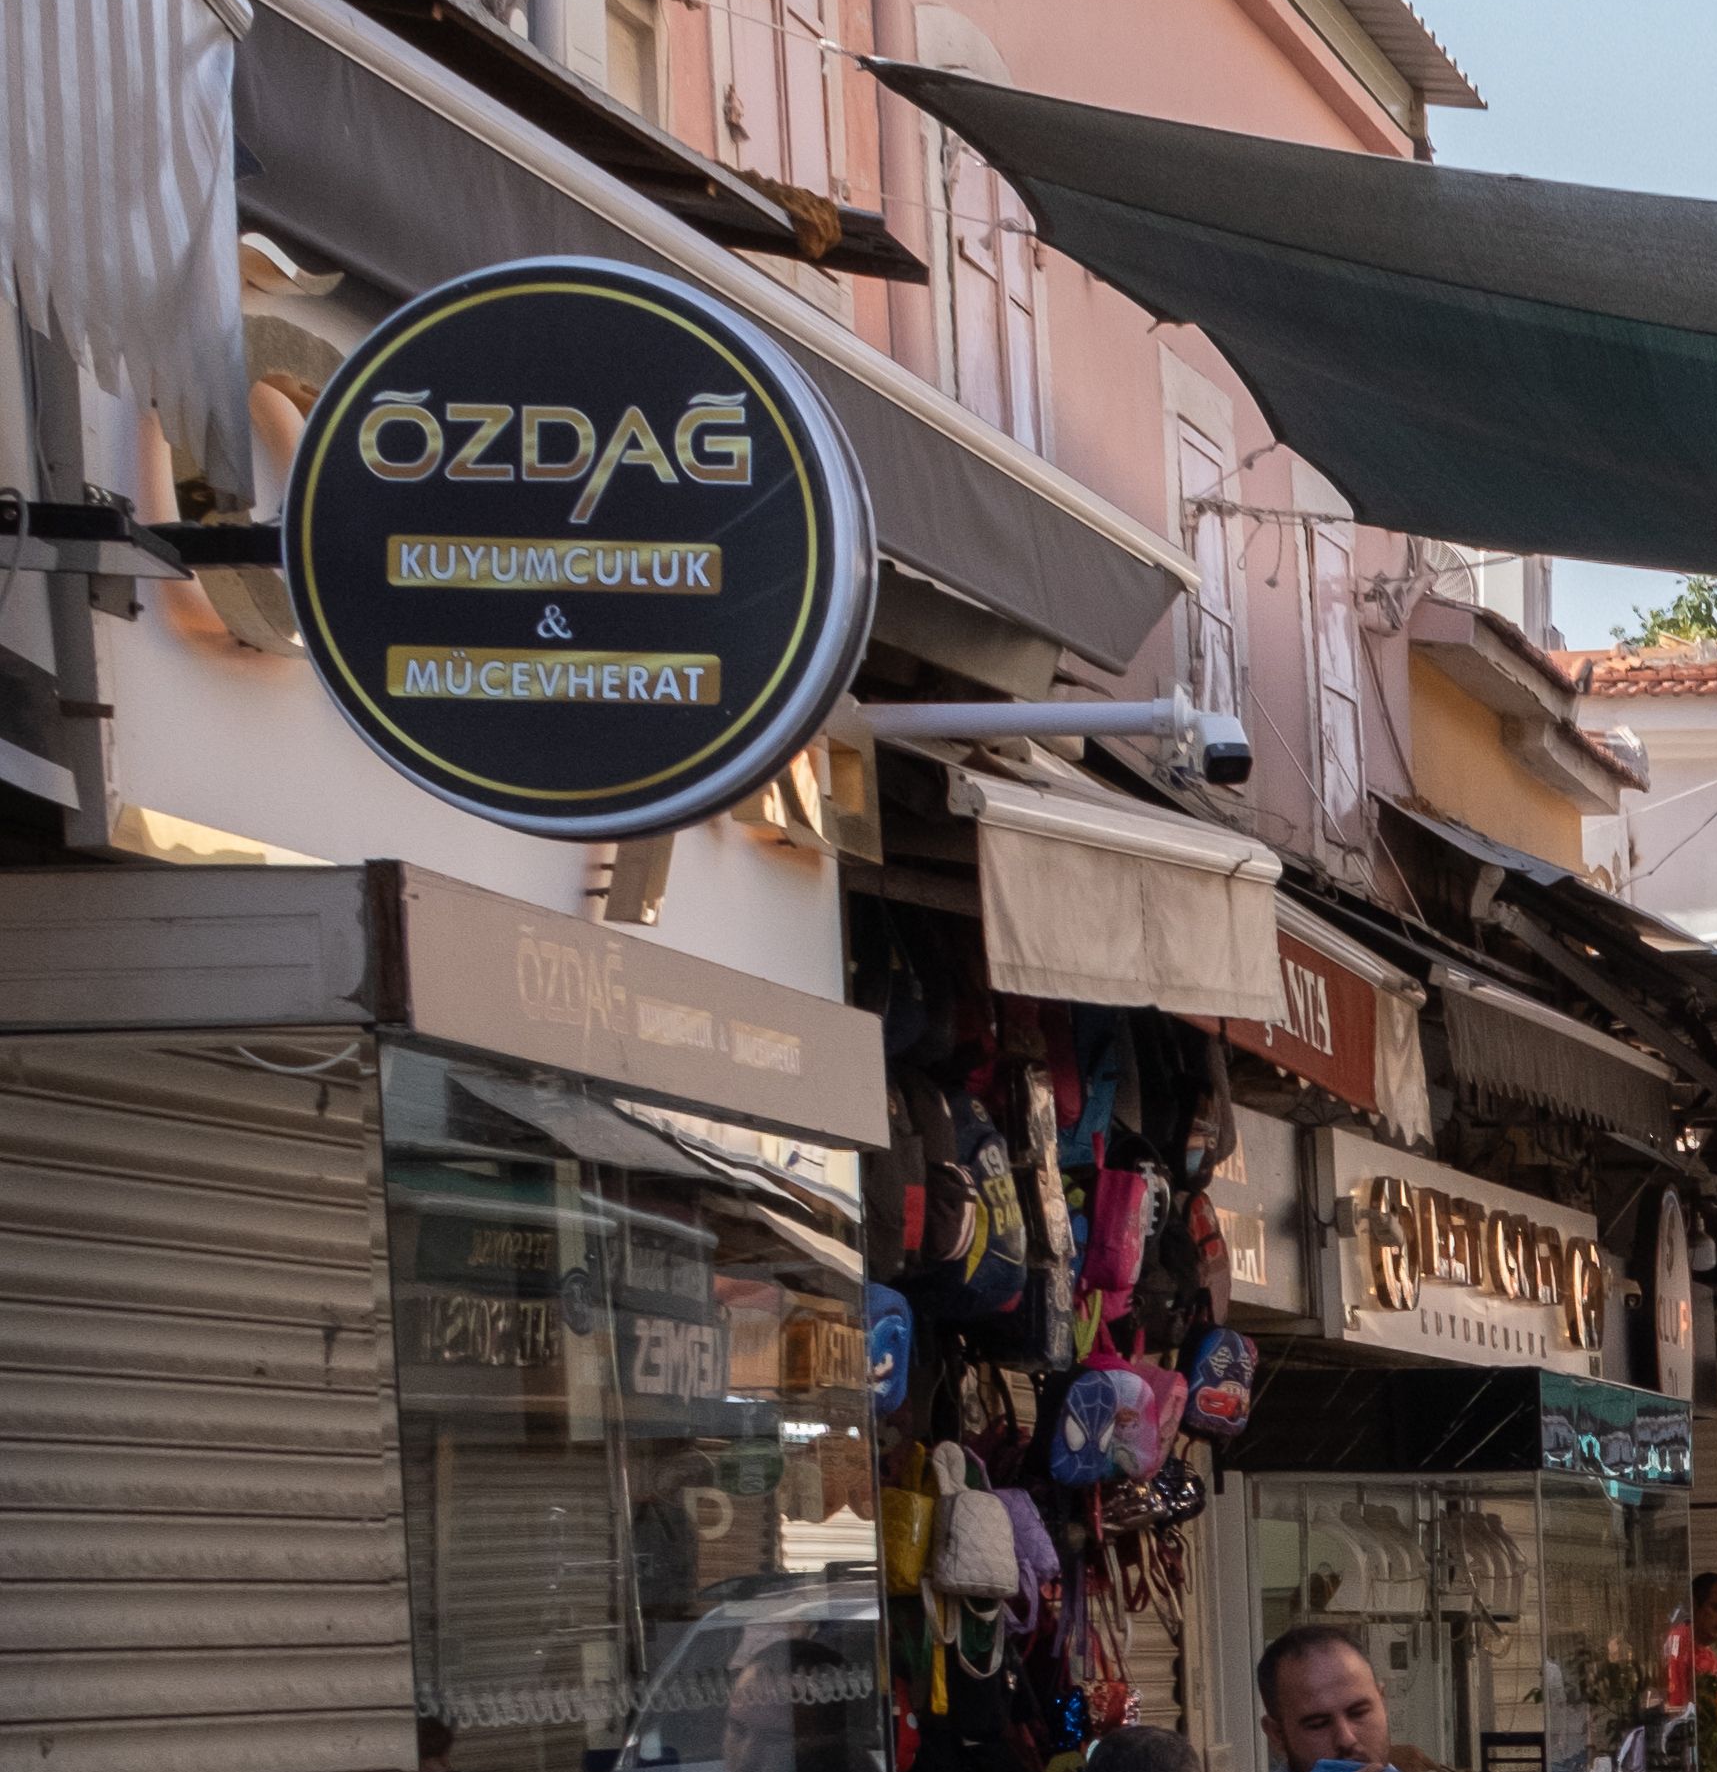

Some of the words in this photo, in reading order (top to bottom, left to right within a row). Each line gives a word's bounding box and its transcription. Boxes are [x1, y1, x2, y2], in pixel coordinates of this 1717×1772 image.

[359, 389, 752, 524] ÖZDAĞ
[400, 543, 711, 587] KUYUMCULUK
[536, 604, 573, 639] &
[404, 650, 704, 702] MÜCEVHERAT
